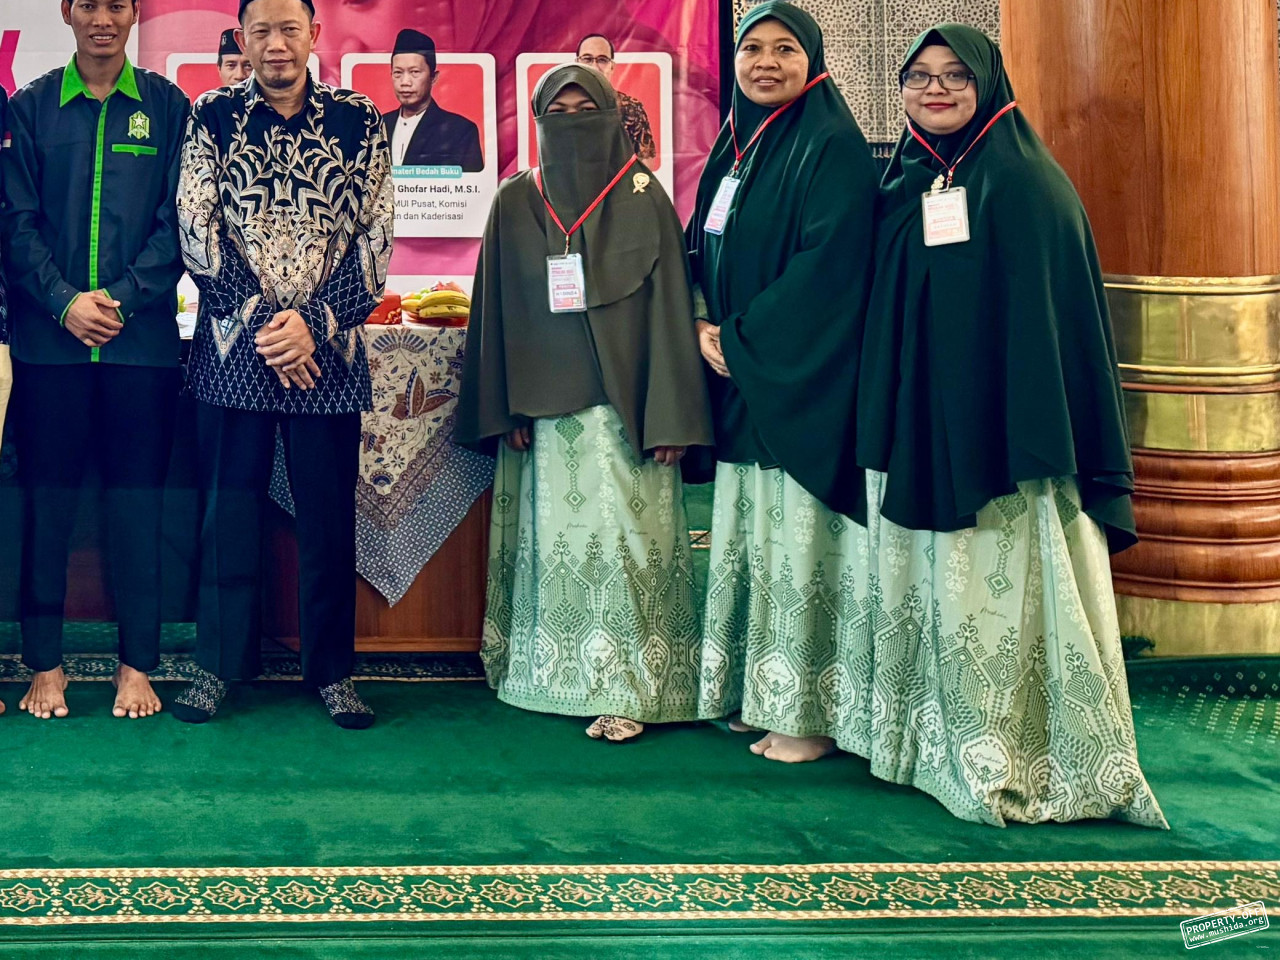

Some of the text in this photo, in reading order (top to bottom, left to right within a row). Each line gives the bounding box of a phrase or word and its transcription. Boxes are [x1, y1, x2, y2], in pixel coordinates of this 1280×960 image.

[416, 167, 439, 175] Bedah
[441, 167, 459, 175] Buku
[398, 184, 427, 193] Ghofar
[429, 184, 452, 195] Hadi,
[455, 185, 480, 193] M.S.I.
[412, 200, 437, 209] Pusat,
[439, 200, 467, 208] Komisi
[403, 212, 419, 220] dan
[421, 212, 464, 220] Kaderisasi
